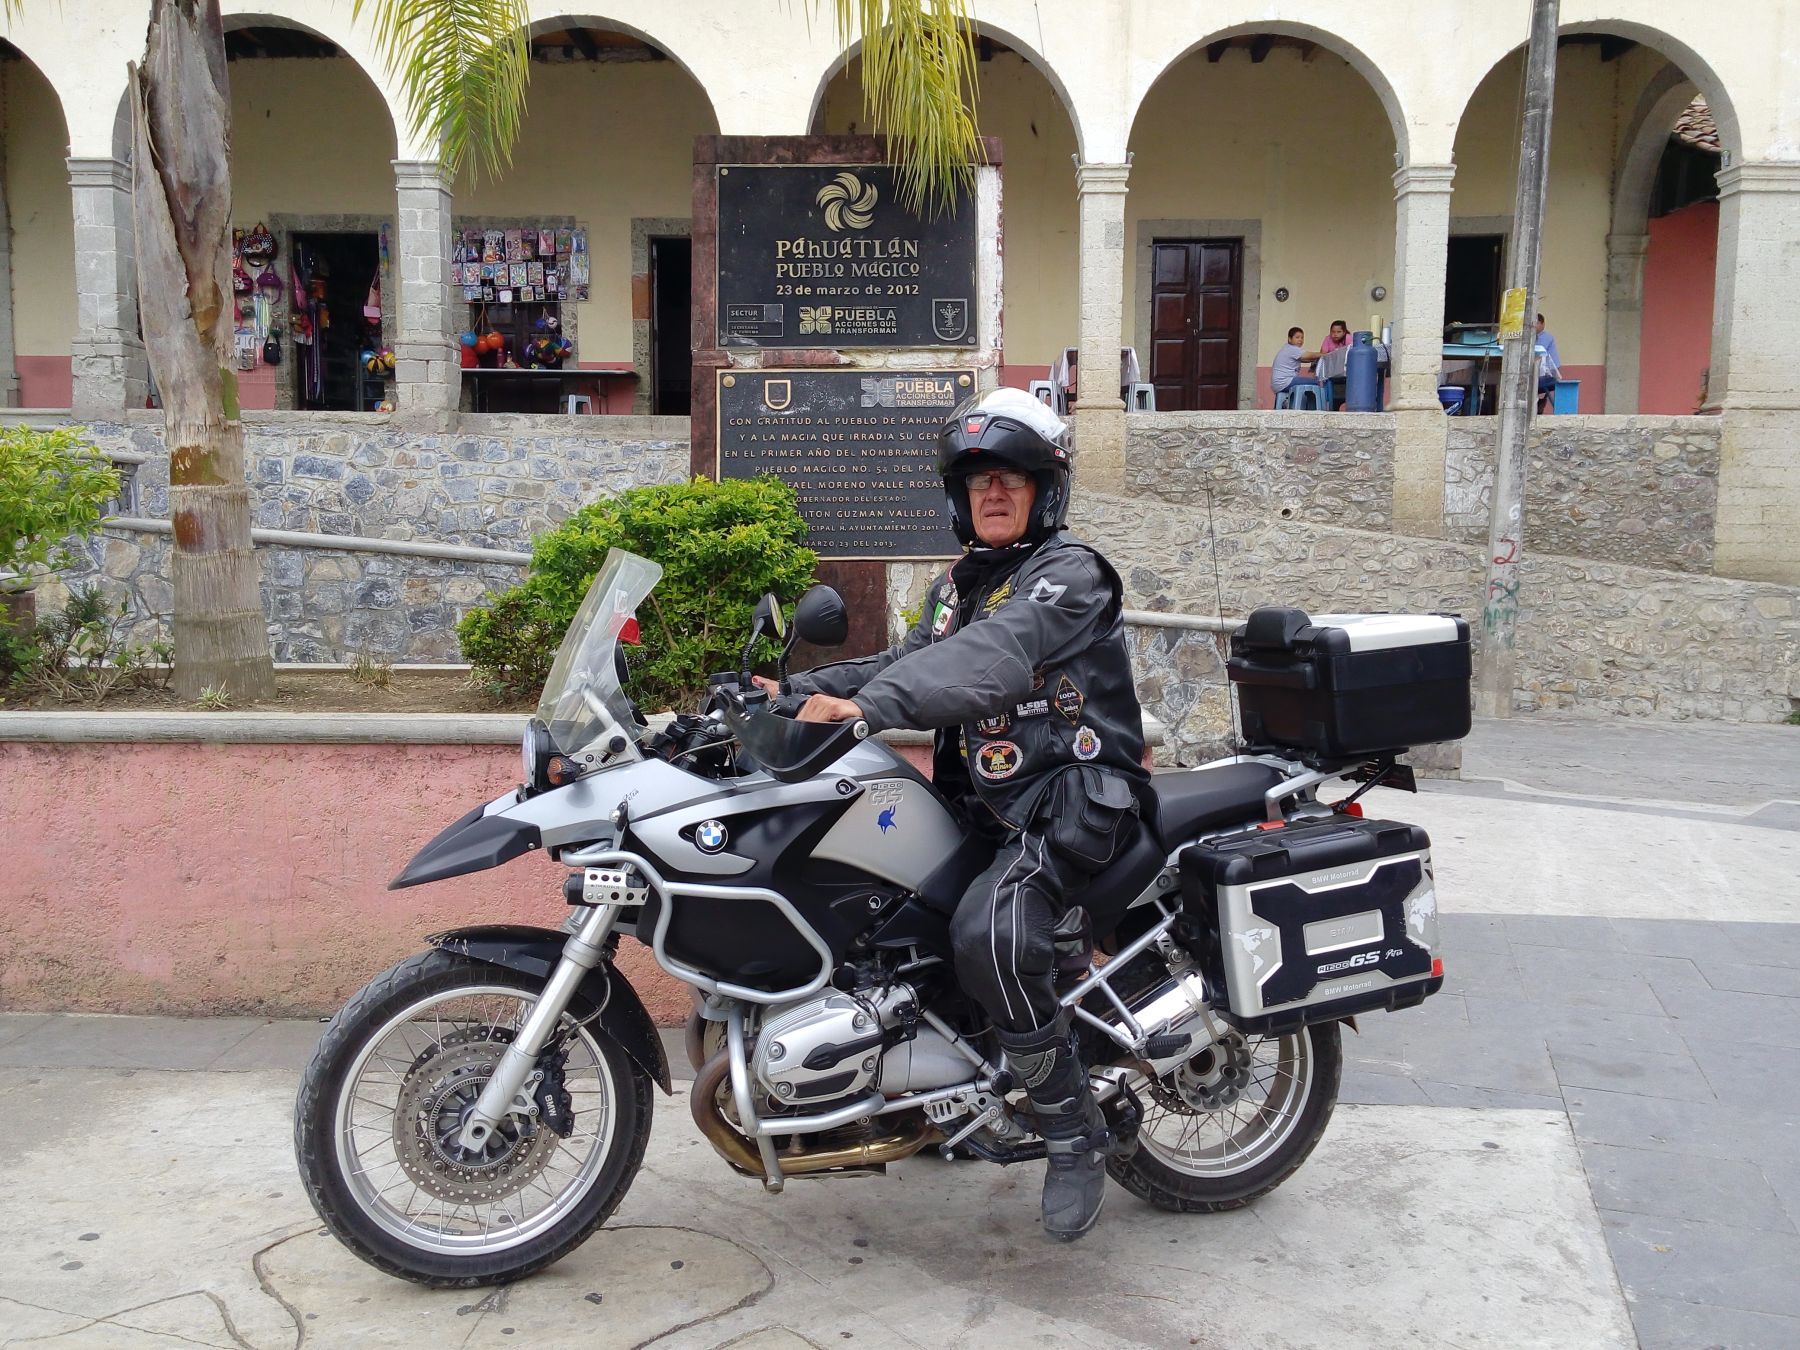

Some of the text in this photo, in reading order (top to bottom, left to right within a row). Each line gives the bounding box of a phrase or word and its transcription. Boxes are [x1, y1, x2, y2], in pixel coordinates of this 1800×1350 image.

[776, 284, 919, 295] 23 de marzo de 2012
[834, 309, 896, 321] PUEBLA
[895, 381, 954, 393] PUEBLA
[729, 418, 752, 426] CON
[757, 417, 812, 426] GRATITUD
[834, 417, 877, 425] PUEBLO
[901, 416, 948, 424] PAHUATL
[822, 434, 845, 442] QUE
[849, 433, 895, 441] IRRADIA
[899, 432, 913, 440] SU
[918, 432, 939, 440] GEN
[724, 450, 738, 458] EN
[744, 450, 756, 458] EL
[808, 448, 831, 457] AÑO
[836, 449, 856, 457] DEL
[861, 448, 938, 456] NOMBRAMIEN
[803, 465, 847, 473] MAGICO
[852, 465, 871, 473] NO.
[876, 466, 888, 475] 54
[893, 465, 914, 473] DEL
[871, 481, 904, 489] VALLE
[909, 480, 945, 488] ROSAS
[798, 510, 940, 518] LITON GUZMAN VALLEJO.
[848, 524, 918, 532] AYUNTAMIENTO
[921, 524, 938, 532] 2011
[870, 790, 904, 805] GS
[1312, 869, 1359, 884] BMW Motorrad
[1331, 926, 1355, 937] BMW
[1325, 981, 1372, 996] BMW Motorrad
[544, 1094, 558, 1117] BMW
